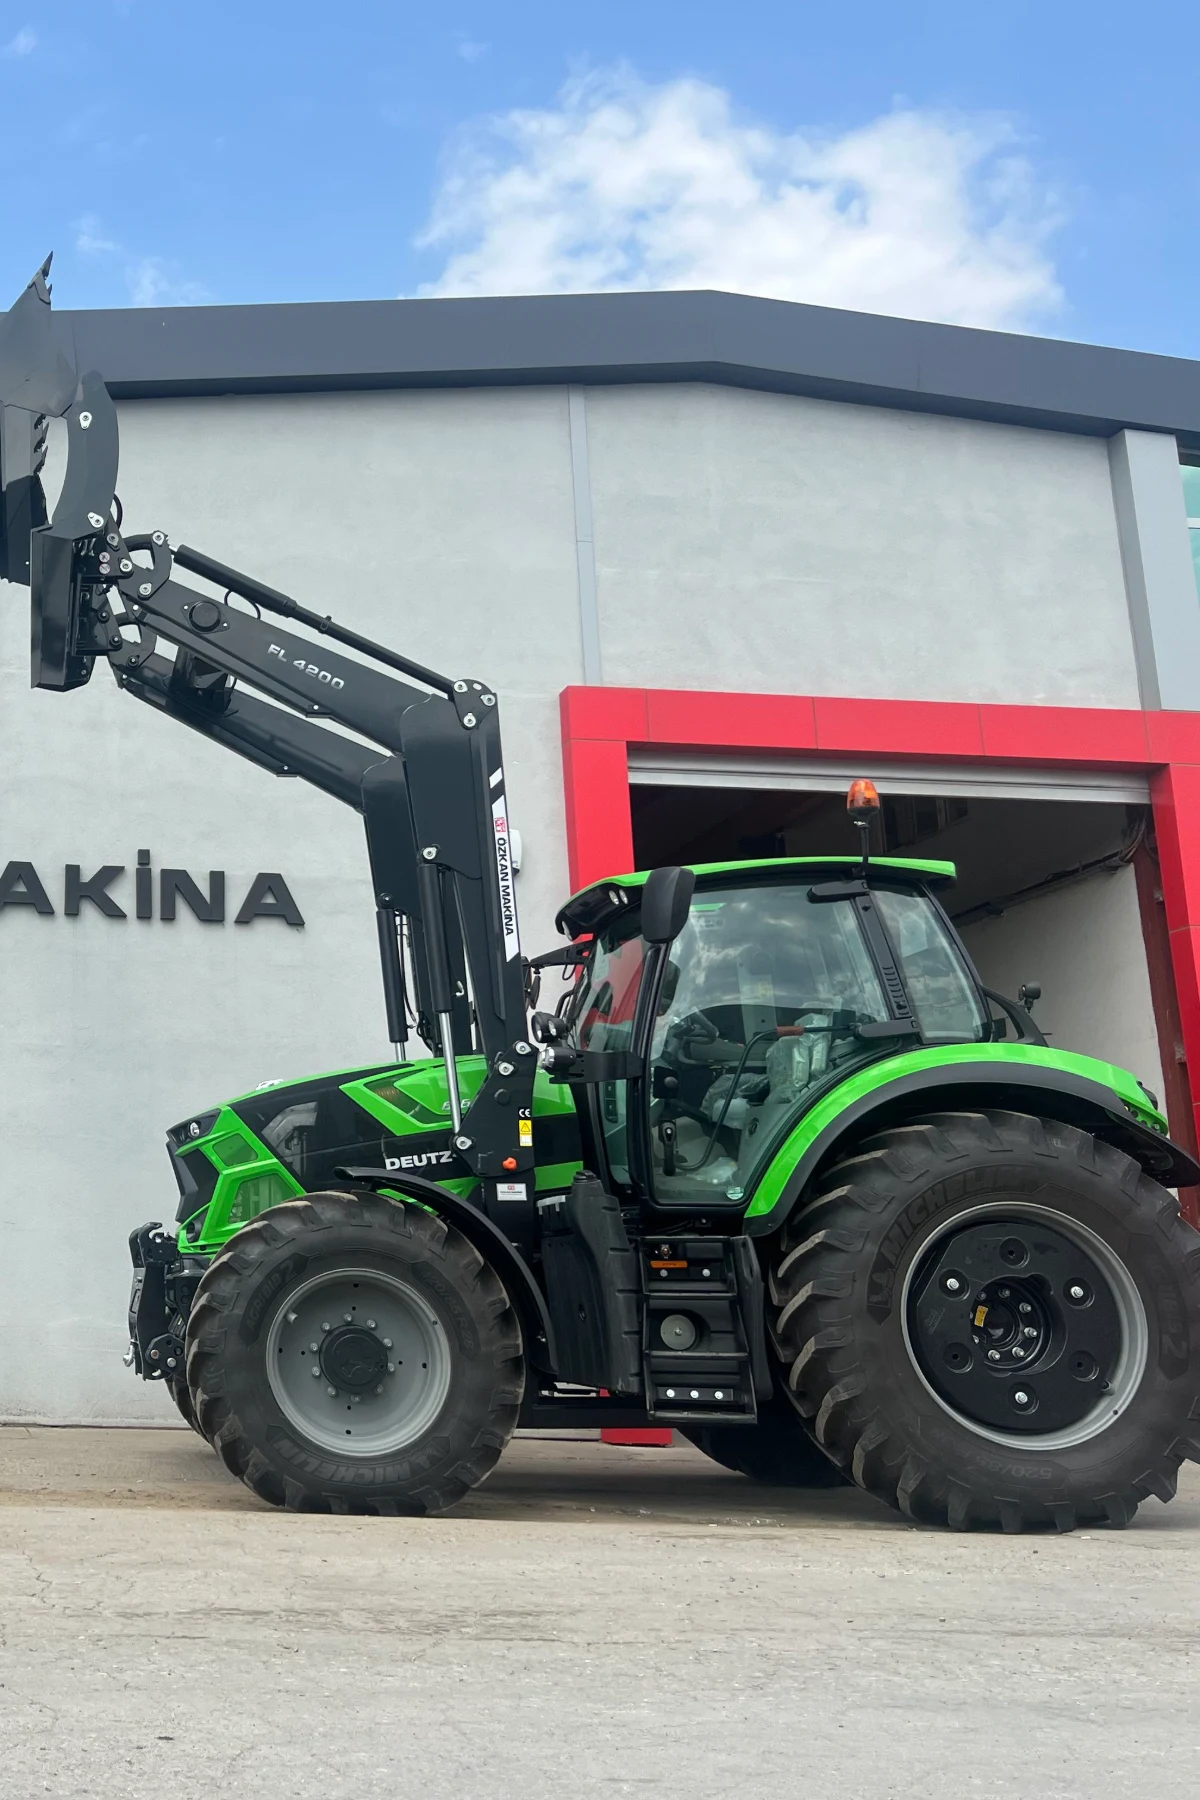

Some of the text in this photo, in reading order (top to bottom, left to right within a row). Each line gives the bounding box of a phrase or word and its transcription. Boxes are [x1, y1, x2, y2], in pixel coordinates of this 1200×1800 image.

[267, 643, 345, 690] FL 4200
[497, 837, 514, 936] ÖZKAN MAKİNA
[519, 1108, 531, 1118] CE
[272, 1438, 411, 1485] MICHELIN
